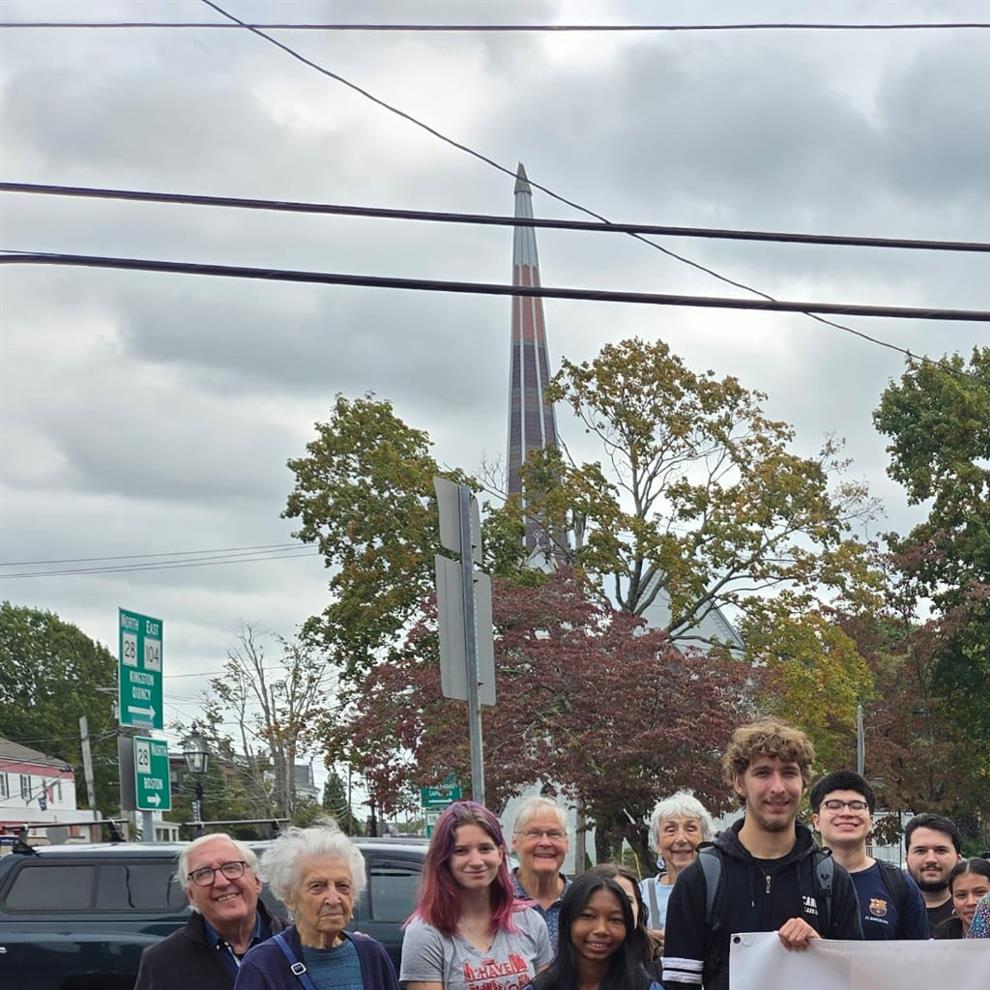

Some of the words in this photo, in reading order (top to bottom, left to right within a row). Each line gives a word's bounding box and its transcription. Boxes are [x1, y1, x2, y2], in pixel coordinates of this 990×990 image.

[125, 640, 136, 659] 28
[146, 645, 159, 664] 104
[139, 748, 149, 766] 28
[478, 961, 512, 979] HAVE
